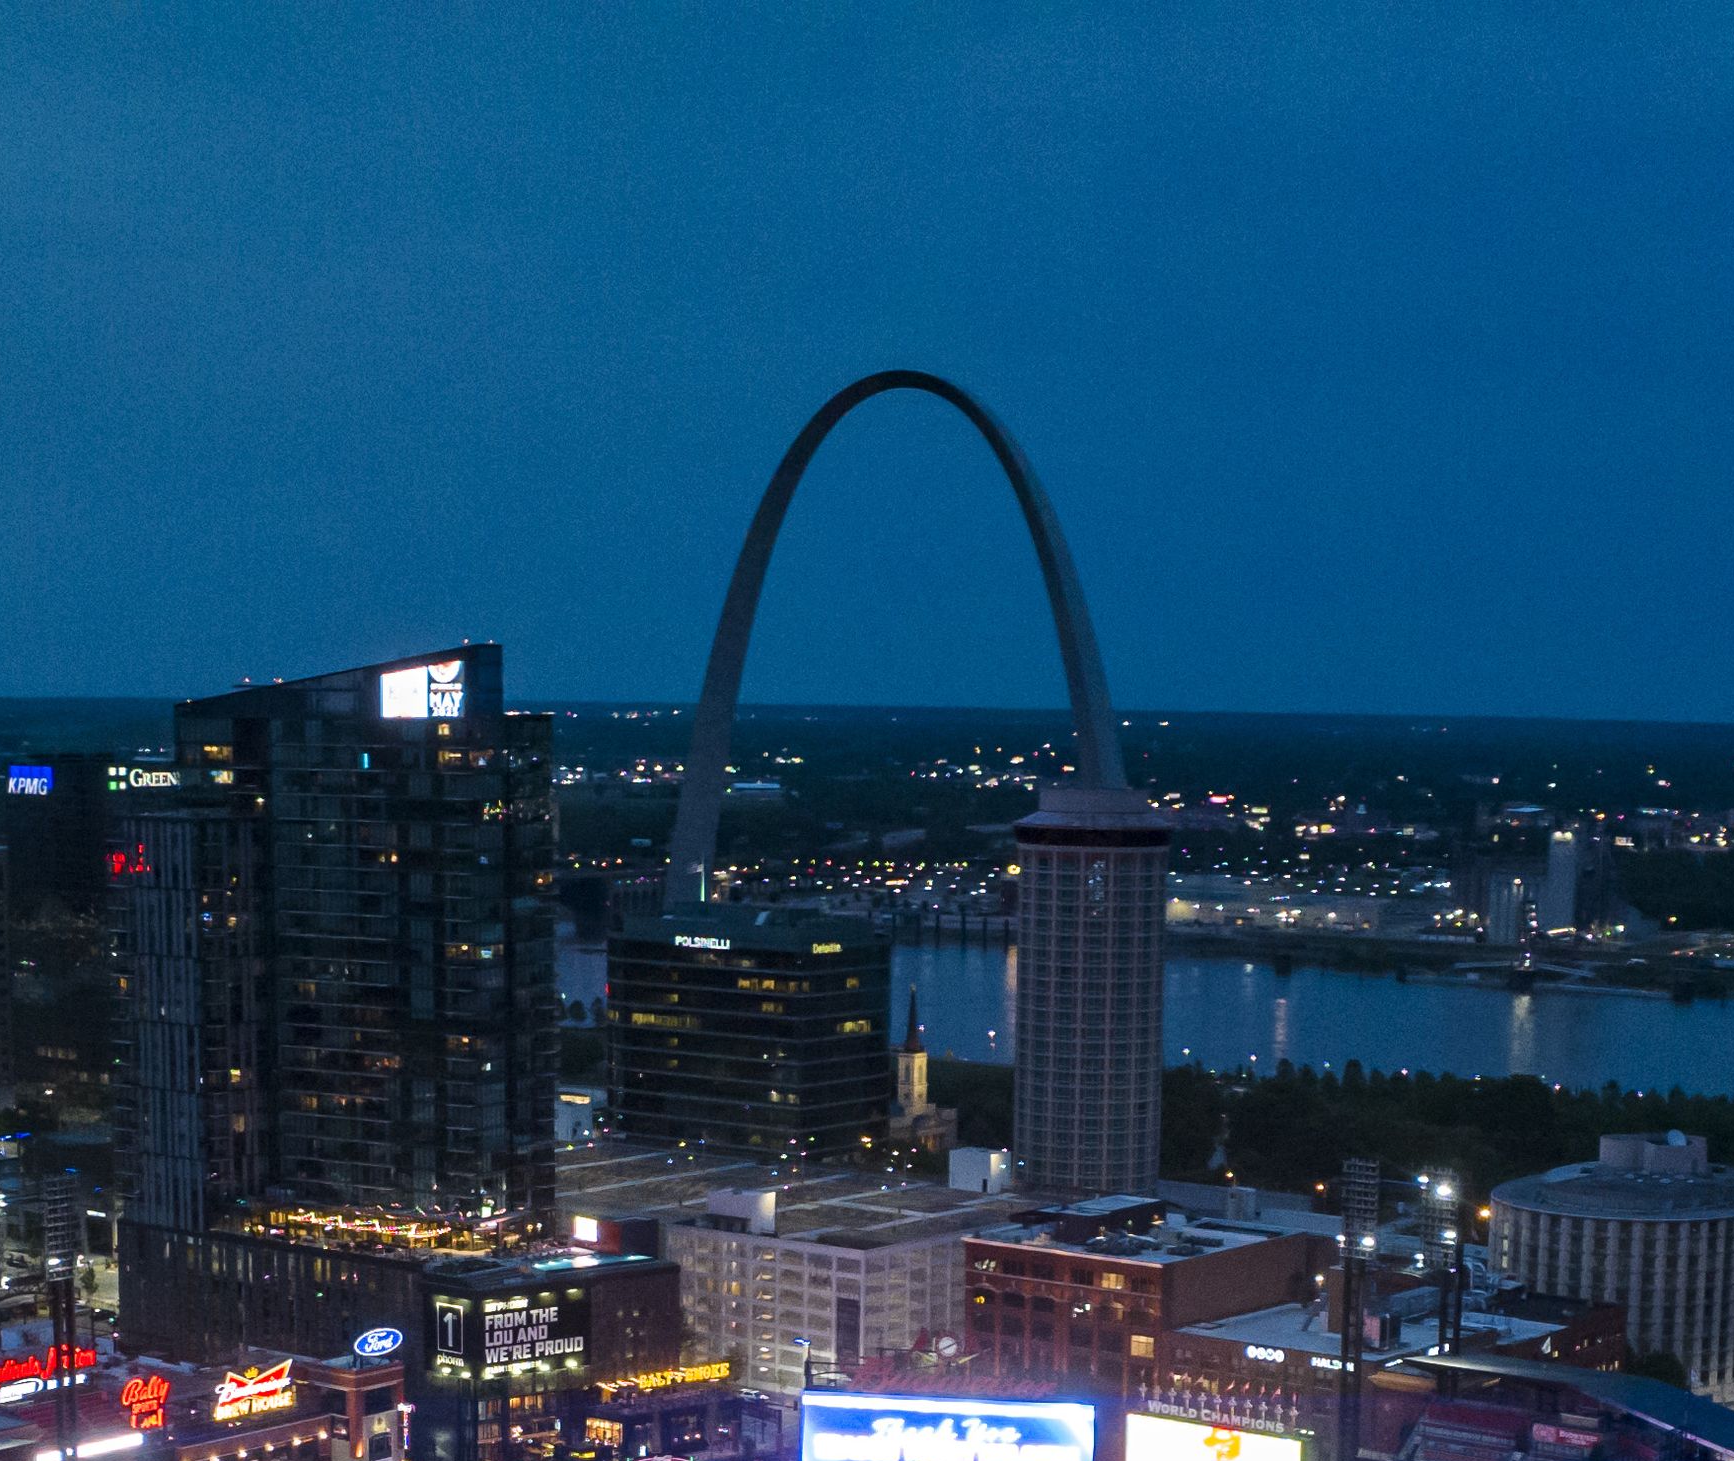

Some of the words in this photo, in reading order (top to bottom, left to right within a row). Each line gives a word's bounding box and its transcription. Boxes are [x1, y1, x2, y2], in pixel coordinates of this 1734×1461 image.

[429, 691, 464, 708] MAY
[8, 777, 48, 796] KPMG
[674, 935, 731, 950] POLSINELLI
[484, 1310, 527, 1331] FROM
[529, 1306, 558, 1323] THE
[364, 1332, 394, 1353] Ford
[484, 1329, 514, 1348] LOU
[516, 1325, 549, 1343] AND
[436, 1354, 465, 1368] phorm
[484, 1342, 533, 1364] WE'RE
[534, 1336, 584, 1357] PROUD
[685, 1361, 730, 1382] SMOKE
[122, 1375, 170, 1406] Bally
[214, 1402, 251, 1422] BREW
[252, 1391, 294, 1413] HOUSE
[1148, 1399, 1198, 1420] WORLD
[1202, 1408, 1285, 1434] CHAMPIONS
